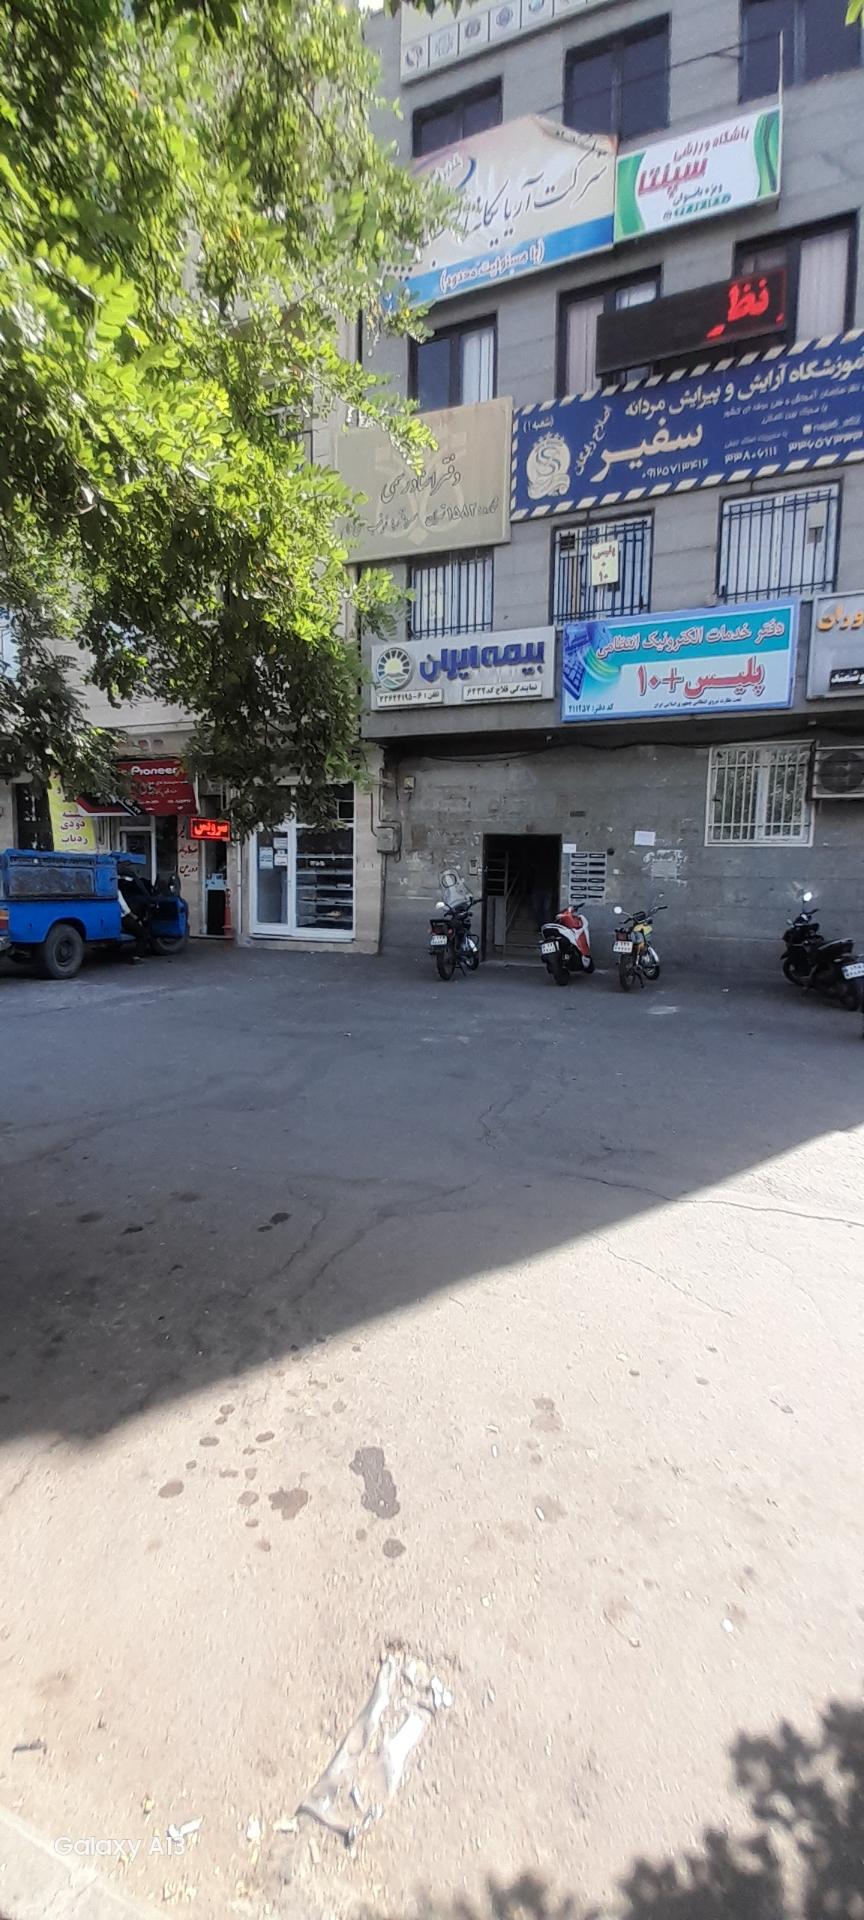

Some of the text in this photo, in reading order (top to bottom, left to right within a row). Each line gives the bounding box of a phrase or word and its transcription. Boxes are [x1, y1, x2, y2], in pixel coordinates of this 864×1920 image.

[673, 126, 750, 162] باشگاه ورزشی
[637, 157, 708, 201] سپنتا
[625, 347, 864, 420] موزشگاه آرایش و پیرایش مردانه
[589, 416, 703, 482] سفیر
[592, 544, 616, 561] پلیس
[596, 617, 786, 661] دفتر خدمات الکترونیک انتظامی
[419, 641, 546, 683] بیمه ایران
[131, 766, 177, 775] Pioneer
[60, 820, 86, 831] دودی
[194, 824, 228, 836] سرویس
